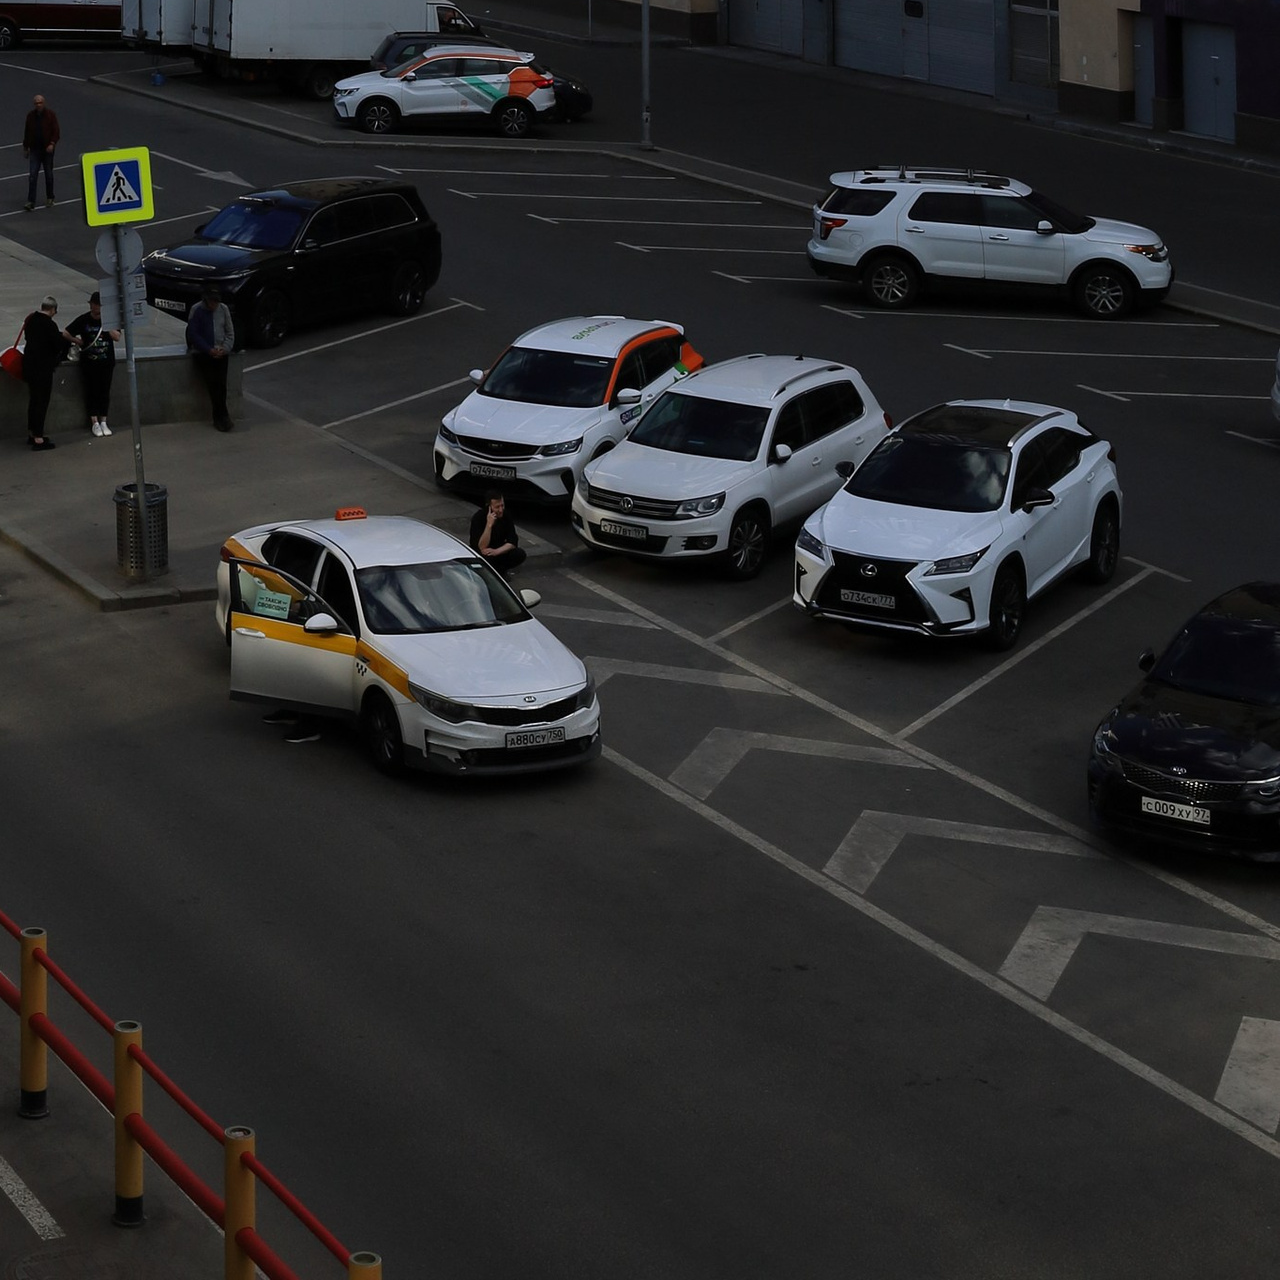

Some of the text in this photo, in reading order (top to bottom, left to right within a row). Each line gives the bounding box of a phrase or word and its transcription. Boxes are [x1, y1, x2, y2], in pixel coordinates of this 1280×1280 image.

[510, 734, 546, 746] А880СУ
[1146, 801, 1207, 819] С009ХУ 97
